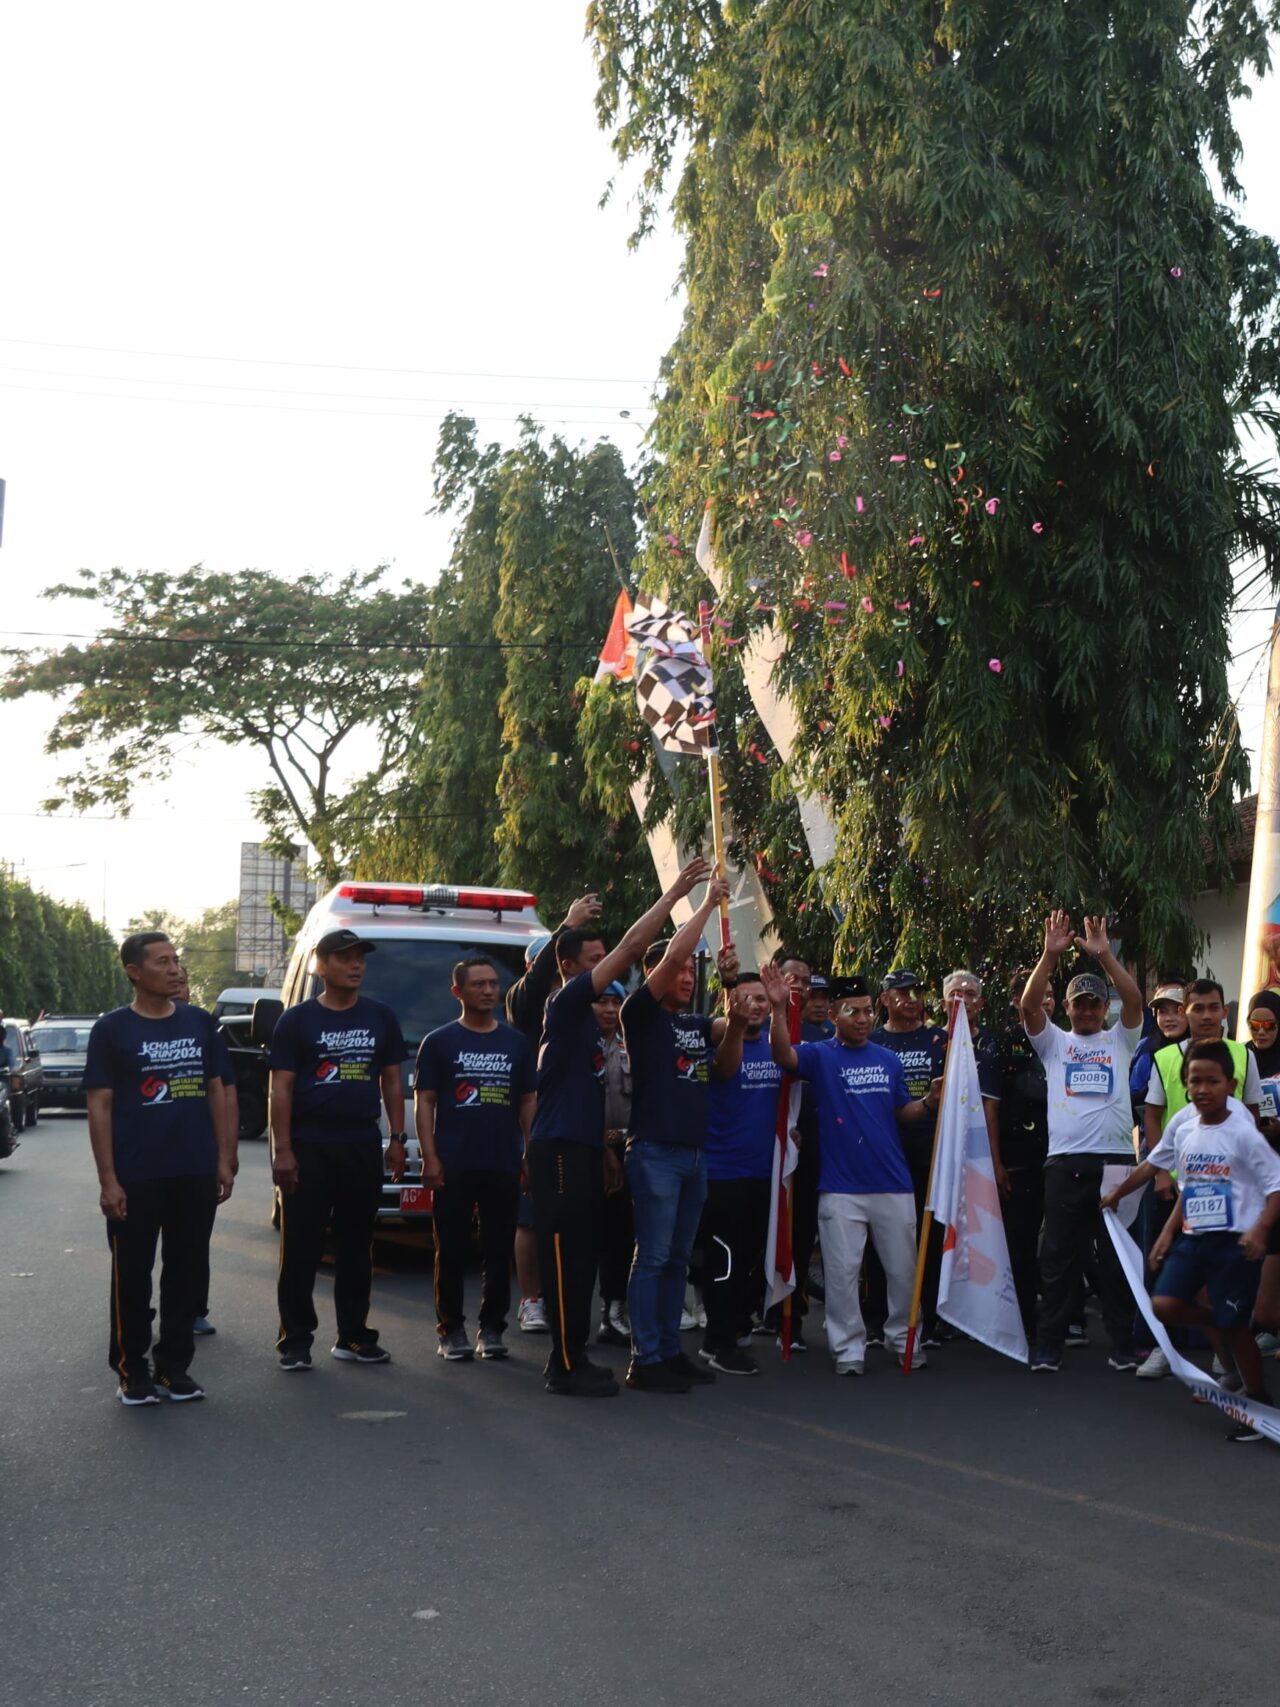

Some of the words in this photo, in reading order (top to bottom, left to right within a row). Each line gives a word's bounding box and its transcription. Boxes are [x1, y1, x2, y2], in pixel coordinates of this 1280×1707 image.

[327, 1029, 370, 1041] CHARITY
[149, 1038, 195, 1050] CHARITY
[150, 1046, 202, 1061] RUN2024
[464, 1052, 508, 1062] CHARITY
[895, 1051, 928, 1061] ARITY
[464, 1060, 513, 1072] RUN2024
[846, 1065, 885, 1076] CHARITY
[847, 1074, 890, 1086] RUN2024
[1073, 1073, 1107, 1083] 50089
[1188, 1199, 1224, 1214] 50187
